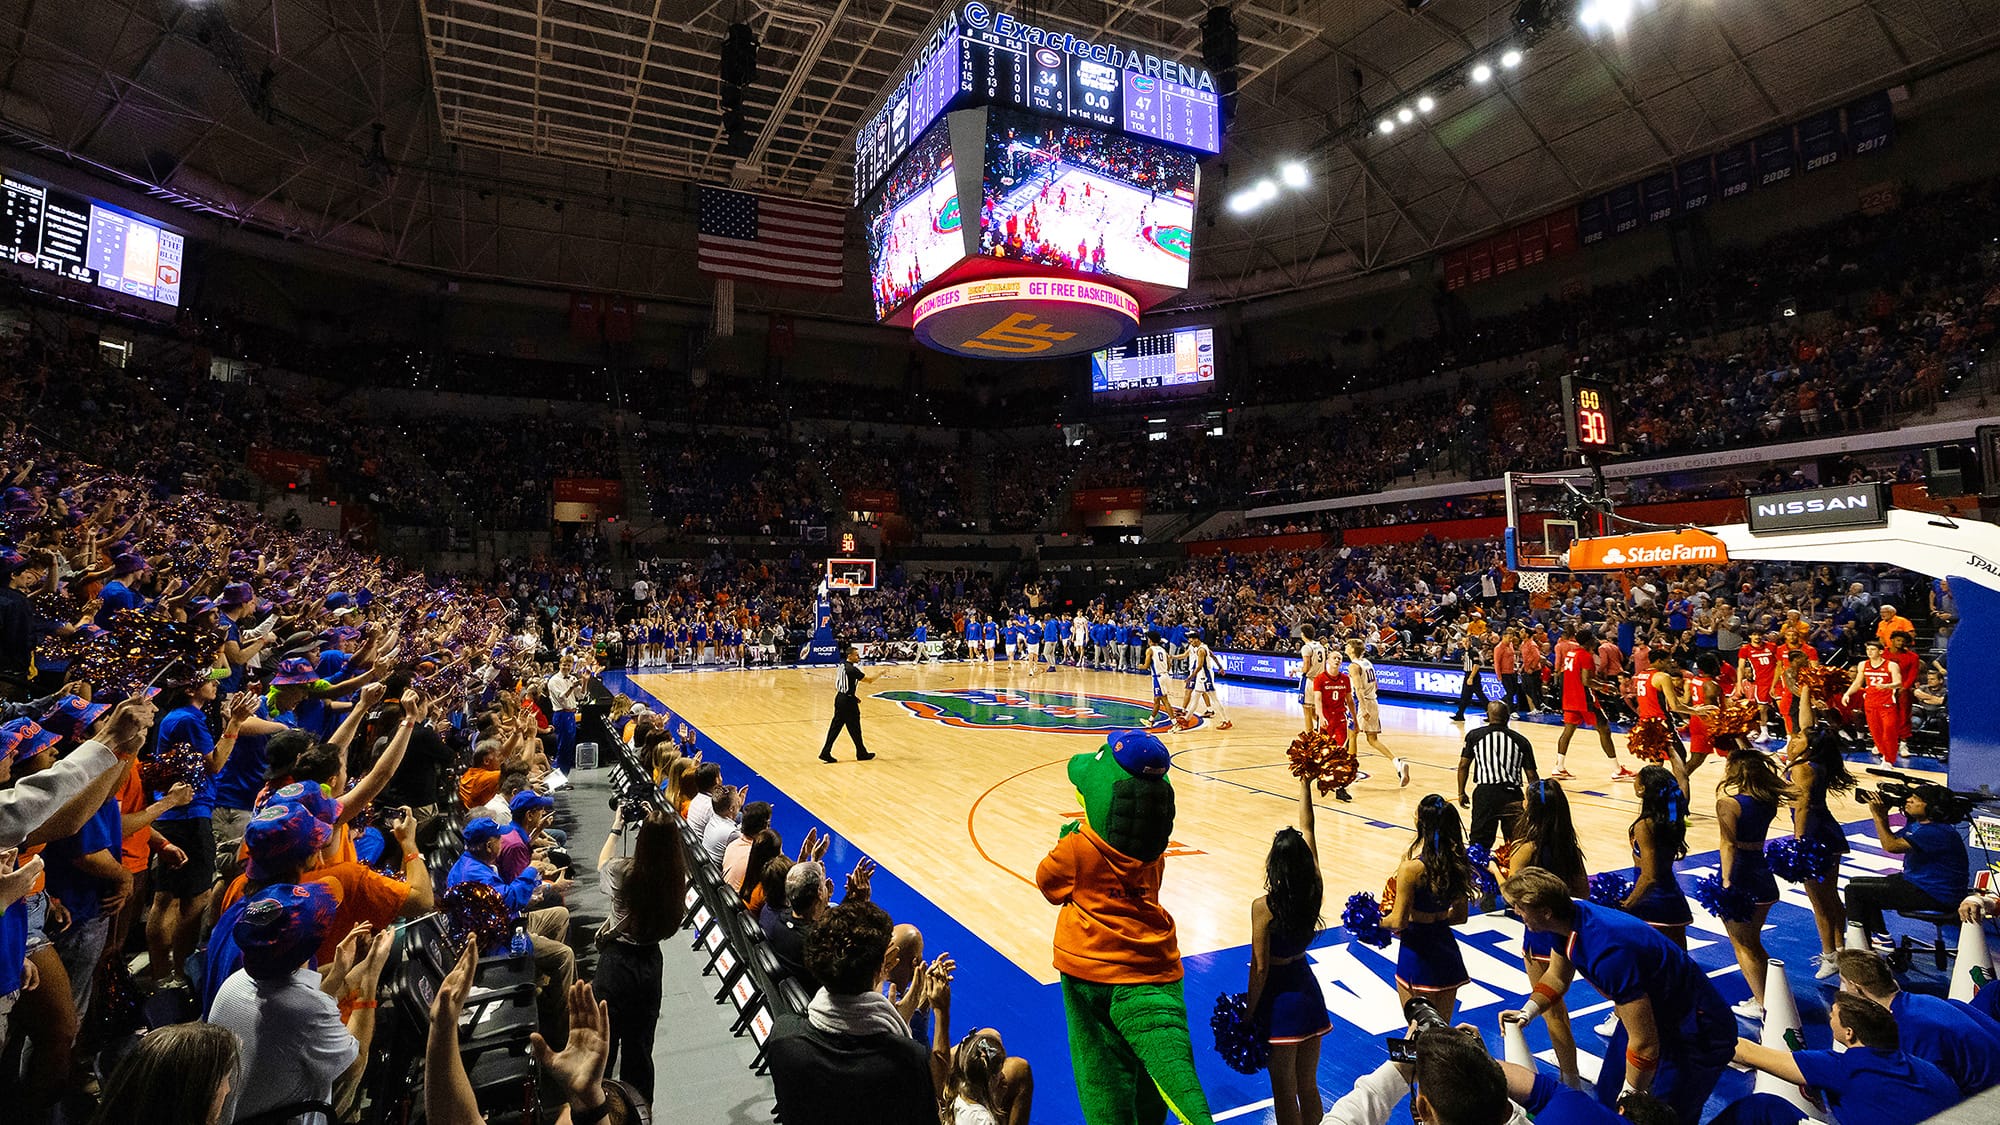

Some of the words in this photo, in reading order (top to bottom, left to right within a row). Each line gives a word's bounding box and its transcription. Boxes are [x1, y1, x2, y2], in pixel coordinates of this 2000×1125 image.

[911, 9, 959, 81] ARENA
[982, 32, 999, 44] PTS
[1006, 39, 1022, 50] FLS
[963, 40, 969, 49] 0
[988, 47, 995, 56] 2
[1014, 54, 1020, 63] 2
[993, 12, 1124, 68] Exactech
[1124, 50, 1217, 93] ARENA
[964, 50, 970, 60] 3
[988, 57, 995, 66] 3
[1014, 64, 1020, 73] 0
[963, 61, 973, 71] 11
[988, 67, 995, 76] 3
[1014, 74, 1020, 83] 0
[1039, 70, 1058, 87] 34
[962, 71, 973, 81] 15
[986, 77, 998, 88] 13
[1014, 84, 1021, 93] 0
[961, 81, 973, 92] 54
[988, 87, 995, 97] 6
[1014, 94, 1021, 103] 0
[1034, 85, 1050, 97] FLS
[1056, 90, 1062, 100] 6
[1181, 86, 1195, 97] PTS
[1200, 92, 1214, 102] FLS
[1034, 97, 1052, 109] TOL
[1056, 102, 1063, 112] 3
[1085, 92, 1109, 109] 0.0
[1135, 96, 1152, 111] 47
[1078, 110, 1090, 119] 1st
[1094, 112, 1115, 125] HALF
[1130, 110, 1145, 121] FLS
[1151, 114, 1156, 123] 9
[1166, 112, 1172, 121] 3
[1185, 109, 1193, 118] 11
[1131, 121, 1147, 132] TOL
[1151, 126, 1156, 135] 4
[1166, 122, 1172, 131] 5
[1185, 127, 1194, 137] 14
[1165, 131, 1174, 141] 10
[1186, 137, 1192, 146] 2
[1857, 134, 1888, 154] 2017
[1807, 152, 1838, 171] 2003
[1762, 167, 1792, 185] 2002
[1685, 194, 1709, 210] 1997
[161, 238, 182, 251] THE
[160, 250, 181, 262] BLUE
[42, 260, 55, 271] 34
[156, 290, 176, 302] LAW
[1029, 282, 1048, 296] GET
[1051, 283, 1075, 297] FREE
[1077, 285, 1125, 309] BASKETBALL
[1579, 410, 1607, 446] 30
[1638, 461, 1680, 474] CENTER
[1685, 455, 1724, 468] COURT
[1730, 452, 1762, 464] CLUB
[1758, 494, 1868, 518] NISSAN
[842, 540, 855, 552] 30
[820, 616, 830, 628] F
[813, 645, 837, 653] ROCKET
[1317, 651, 1323, 663] 3
[1563, 657, 1574, 672] 54
[1758, 656, 1770, 666] 10
[1228, 661, 1244, 672] ART
[1366, 668, 1375, 683] 10
[1378, 678, 1404, 686] MUSEUM
[1869, 676, 1884, 686] 22
[1332, 690, 1339, 701] 0
[1637, 681, 1647, 697] 15
[1692, 686, 1699, 702] 3
